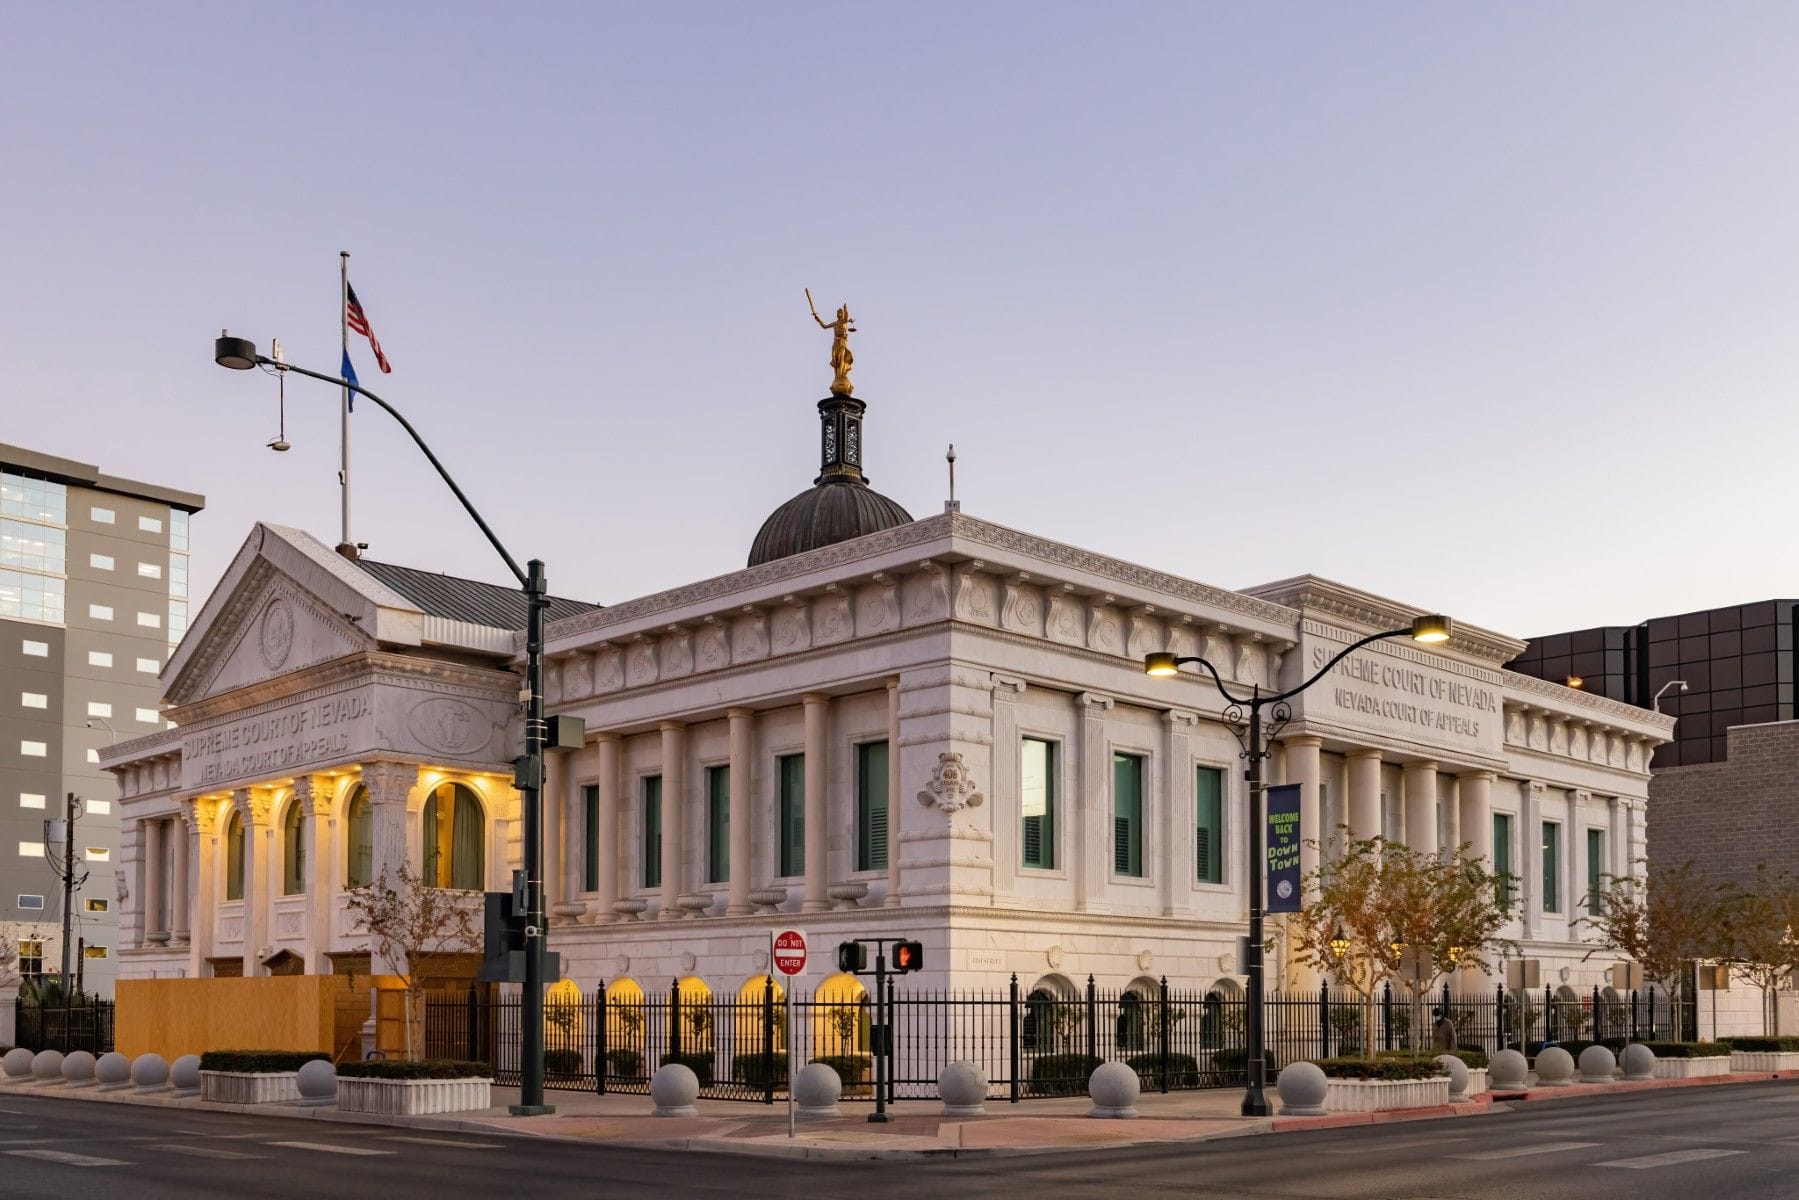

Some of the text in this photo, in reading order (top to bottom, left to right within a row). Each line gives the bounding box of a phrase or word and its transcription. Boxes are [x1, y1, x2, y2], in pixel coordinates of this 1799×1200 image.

[1382, 664, 1427, 696] COURT
[1429, 676, 1446, 700] OF
[1448, 681, 1497, 714] NEVADA
[1335, 687, 1479, 738] NEVADA COURT OF APPEALS
[184, 693, 372, 761] SUPREME COURT OF NEVADA
[201, 733, 348, 782] NEVADA COURT OF APPEALS
[1268, 812, 1299, 824] WELCOME
[1275, 824, 1293, 834] BACK
[1280, 836, 1289, 844] TO
[777, 939, 803, 947] DO NOT
[780, 959, 801, 967] ENTER
